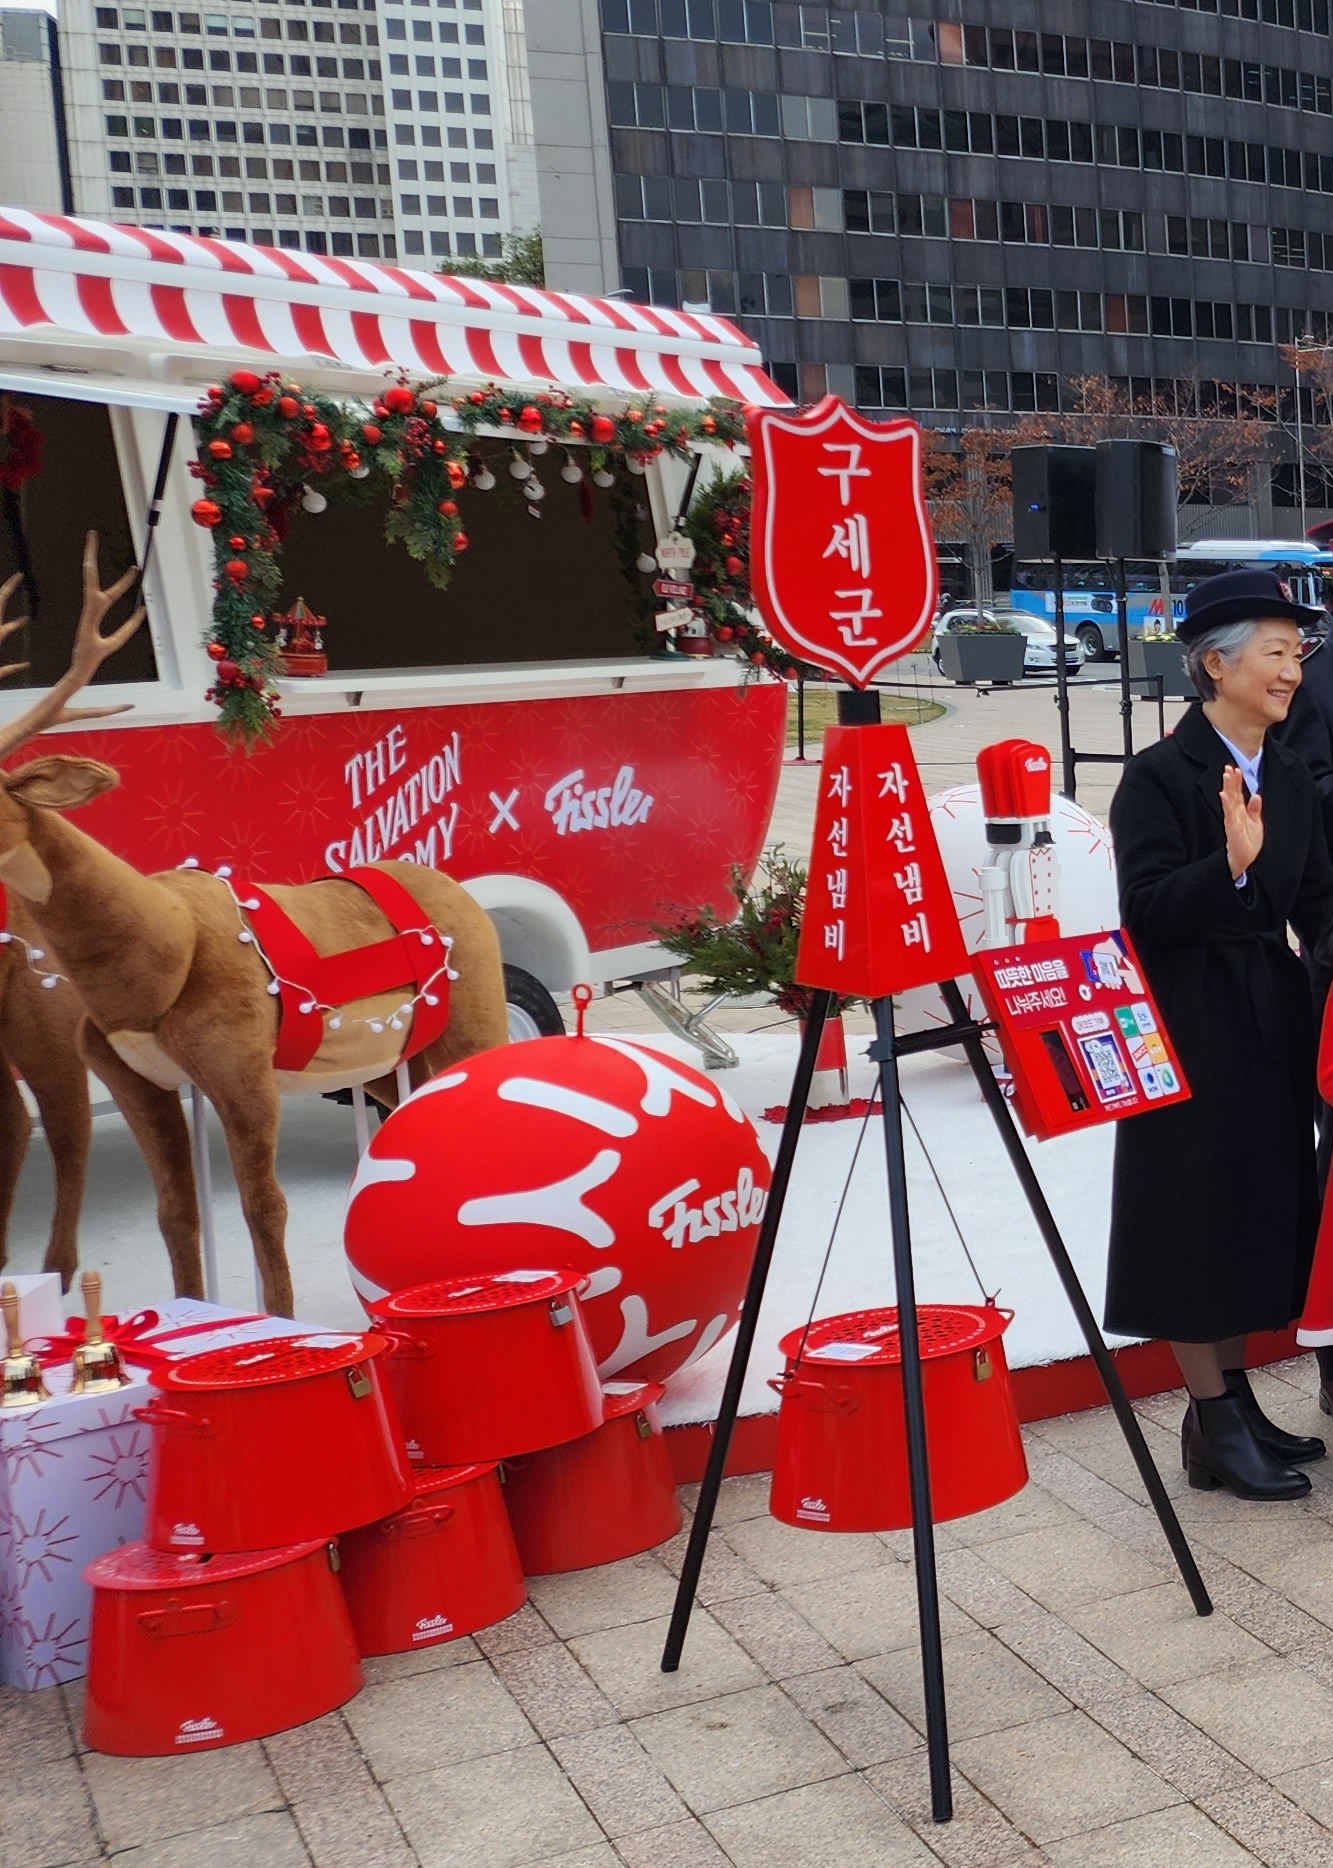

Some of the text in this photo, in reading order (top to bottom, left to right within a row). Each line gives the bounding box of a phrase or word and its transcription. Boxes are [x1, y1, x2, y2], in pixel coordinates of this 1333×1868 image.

[817, 443, 883, 648] 구세군
[325, 731, 462, 873] SALVATION
[344, 724, 408, 810] THE
[543, 765, 655, 836] Fissler
[823, 765, 853, 963] 자선냄비
[877, 762, 933, 955] 자선냄비
[1030, 959, 1069, 983] 마음을
[648, 1167, 770, 1248] Fissle
